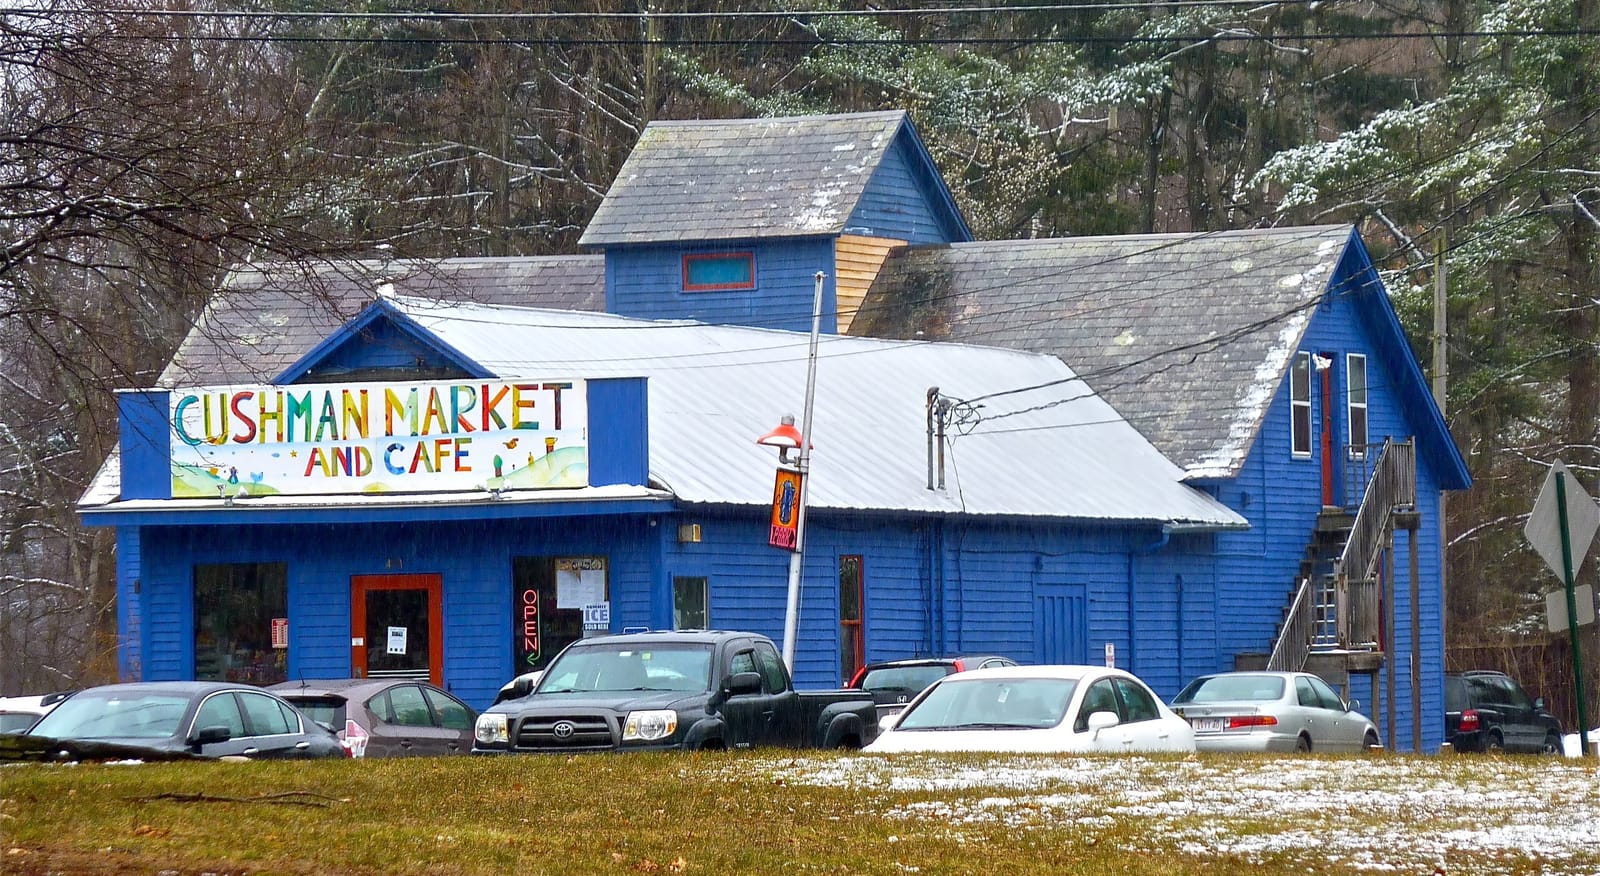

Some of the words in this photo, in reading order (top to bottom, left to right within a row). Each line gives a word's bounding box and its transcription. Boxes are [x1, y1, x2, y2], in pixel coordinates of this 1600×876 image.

[174, 388, 370, 446] CUSHMAN
[384, 382, 573, 437] MARKET
[303, 445, 373, 477] AND
[384, 437, 473, 476] CAFE
[523, 589, 537, 650] OPEN
[585, 609, 608, 622] ICE
